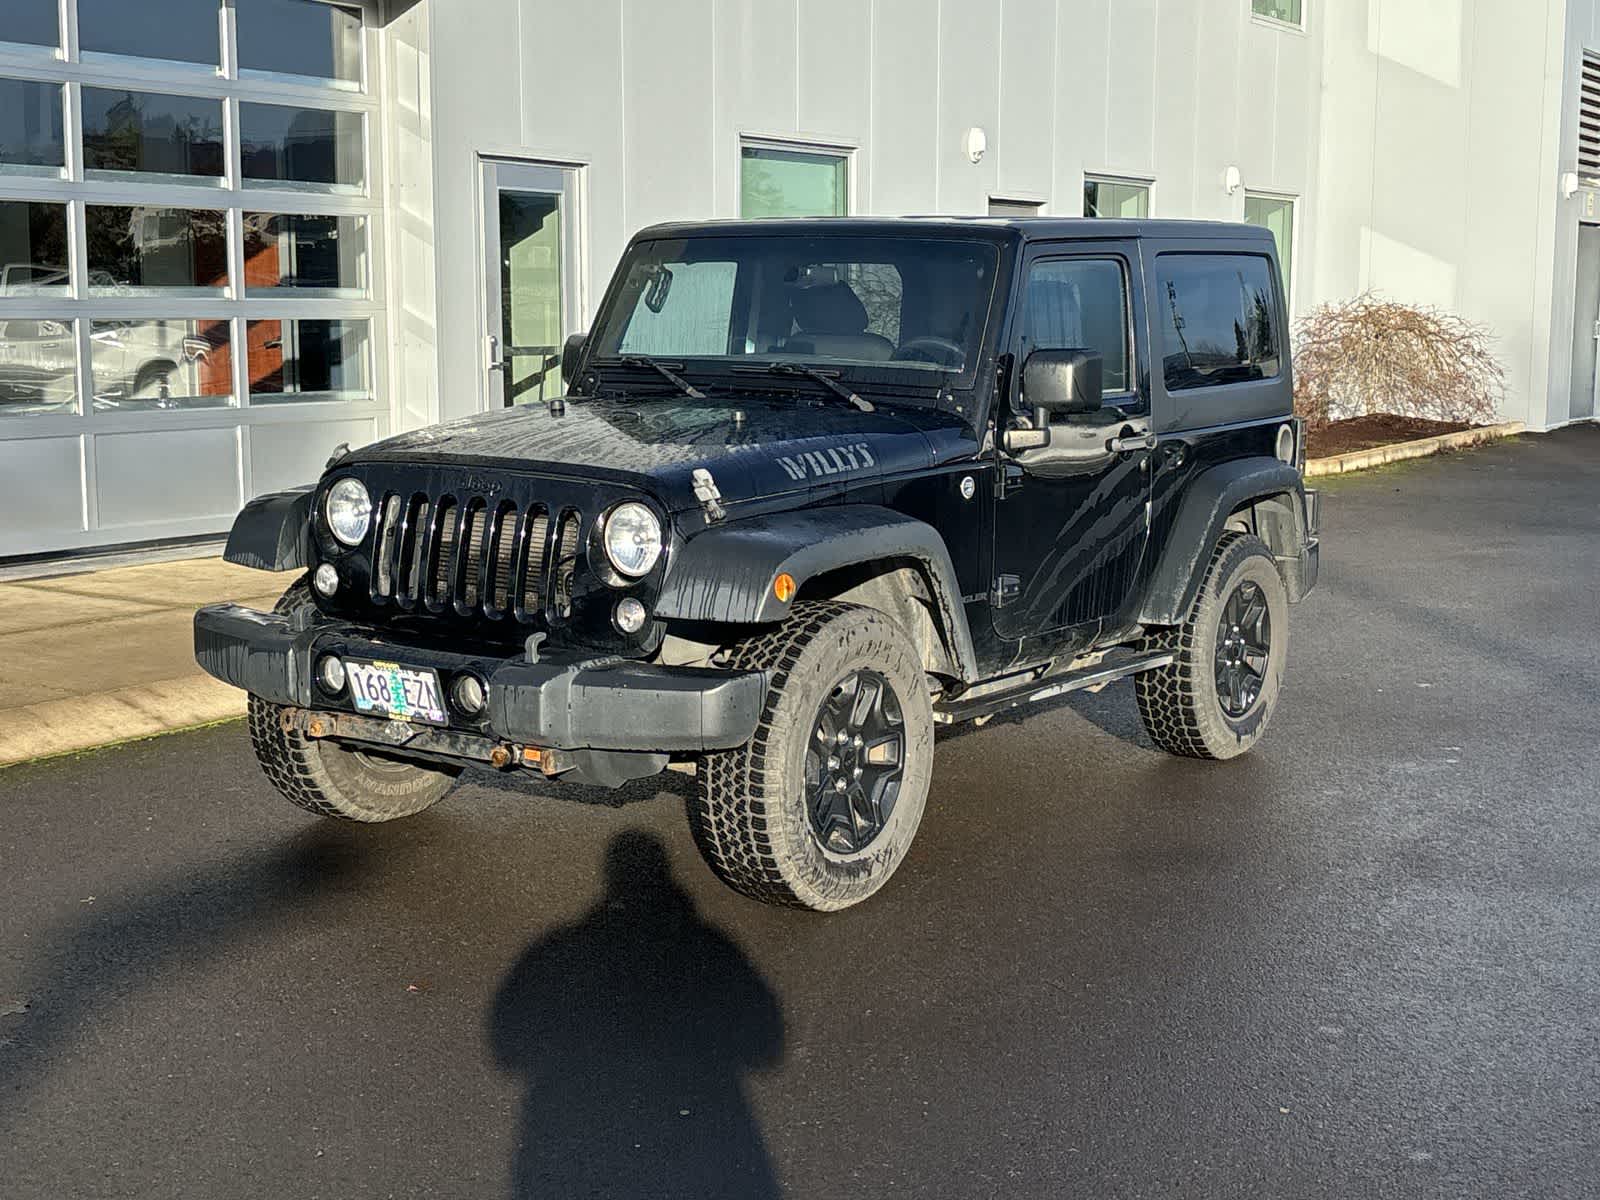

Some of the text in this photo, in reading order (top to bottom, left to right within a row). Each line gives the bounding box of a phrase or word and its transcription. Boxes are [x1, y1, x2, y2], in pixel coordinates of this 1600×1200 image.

[776, 443, 875, 480] WILLYS
[464, 474, 503, 497] Jeep
[353, 671, 392, 703] 168
